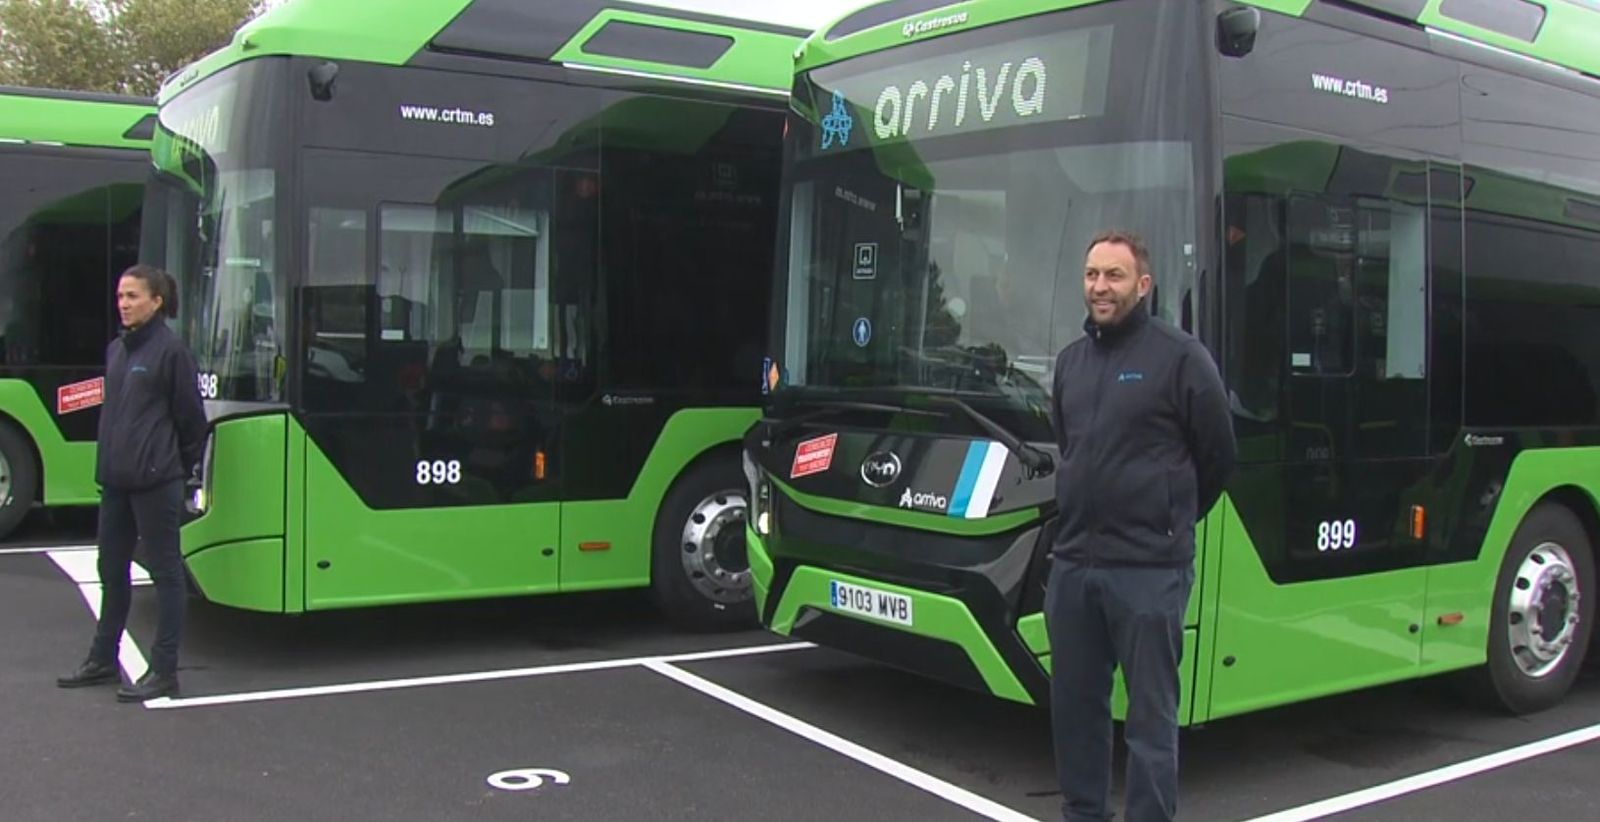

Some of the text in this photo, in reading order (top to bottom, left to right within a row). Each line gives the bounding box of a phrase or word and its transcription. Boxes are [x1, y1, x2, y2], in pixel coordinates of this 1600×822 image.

[873, 57, 1047, 140] arriva
[1311, 73, 1388, 103] www.crtm.es
[400, 105, 494, 126] www.crtm.es
[416, 460, 461, 485] 898
[1317, 519, 1355, 551] 899
[838, 586, 908, 620] 9103 MVB
